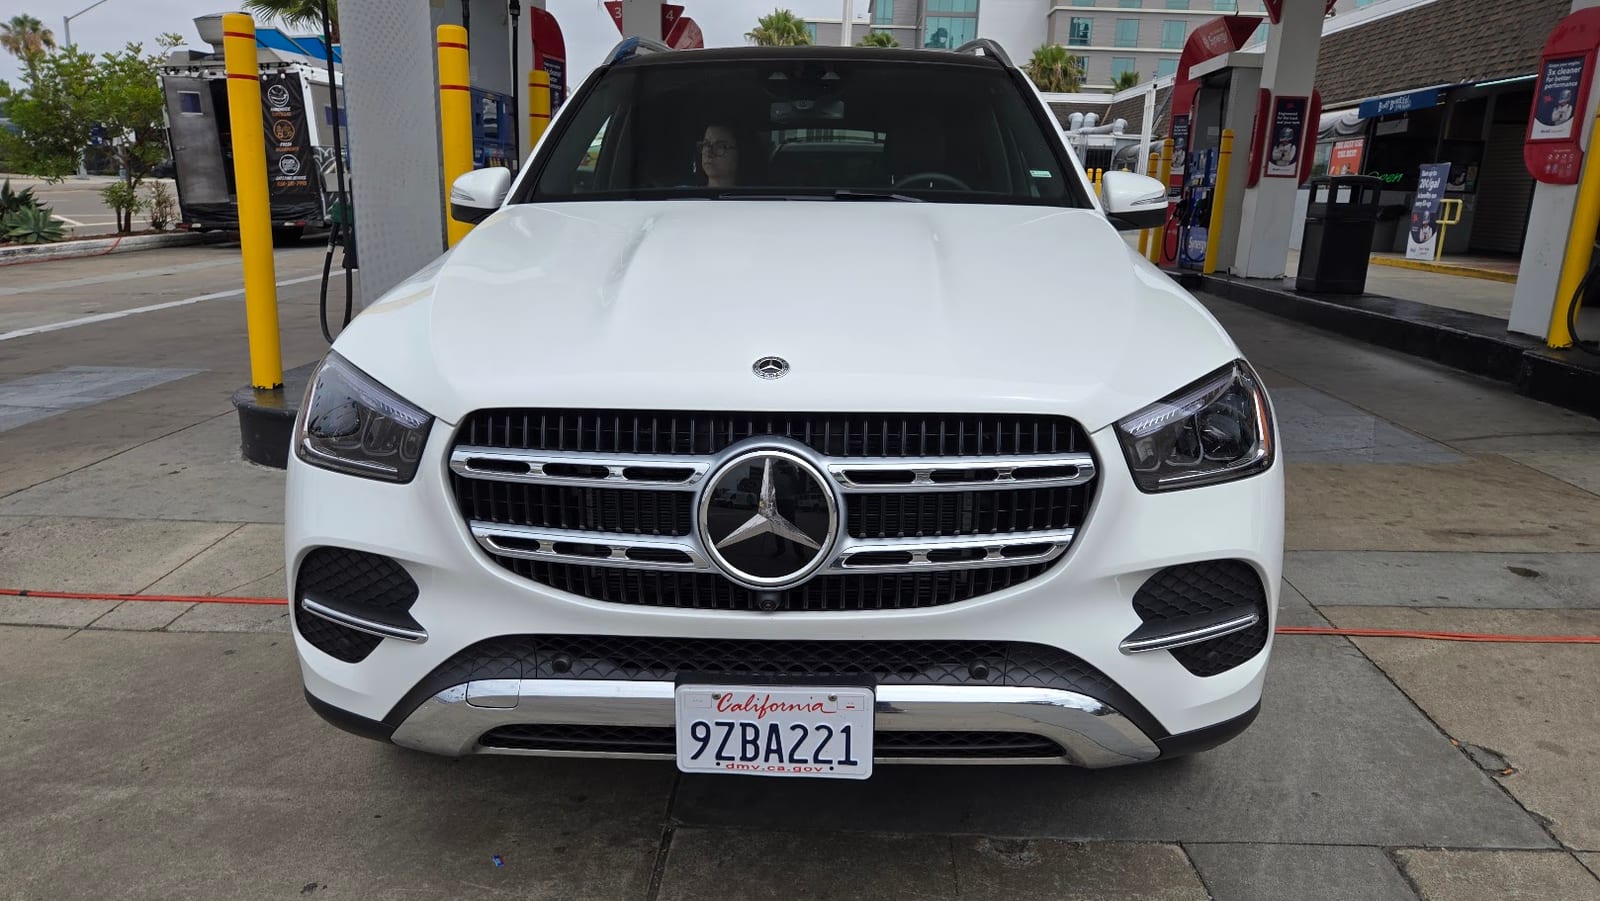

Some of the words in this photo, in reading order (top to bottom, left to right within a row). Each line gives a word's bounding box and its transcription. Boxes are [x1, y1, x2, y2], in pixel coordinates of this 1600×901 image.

[614, 7, 622, 19] 3
[665, 10, 674, 21] 4
[1547, 68, 1556, 76] 3x
[1557, 66, 1582, 76] cleaner
[1544, 81, 1578, 91] performance
[717, 692, 836, 719] California
[690, 720, 858, 766] 9ZBA221
[726, 762, 823, 773] dmv.ca.gov
